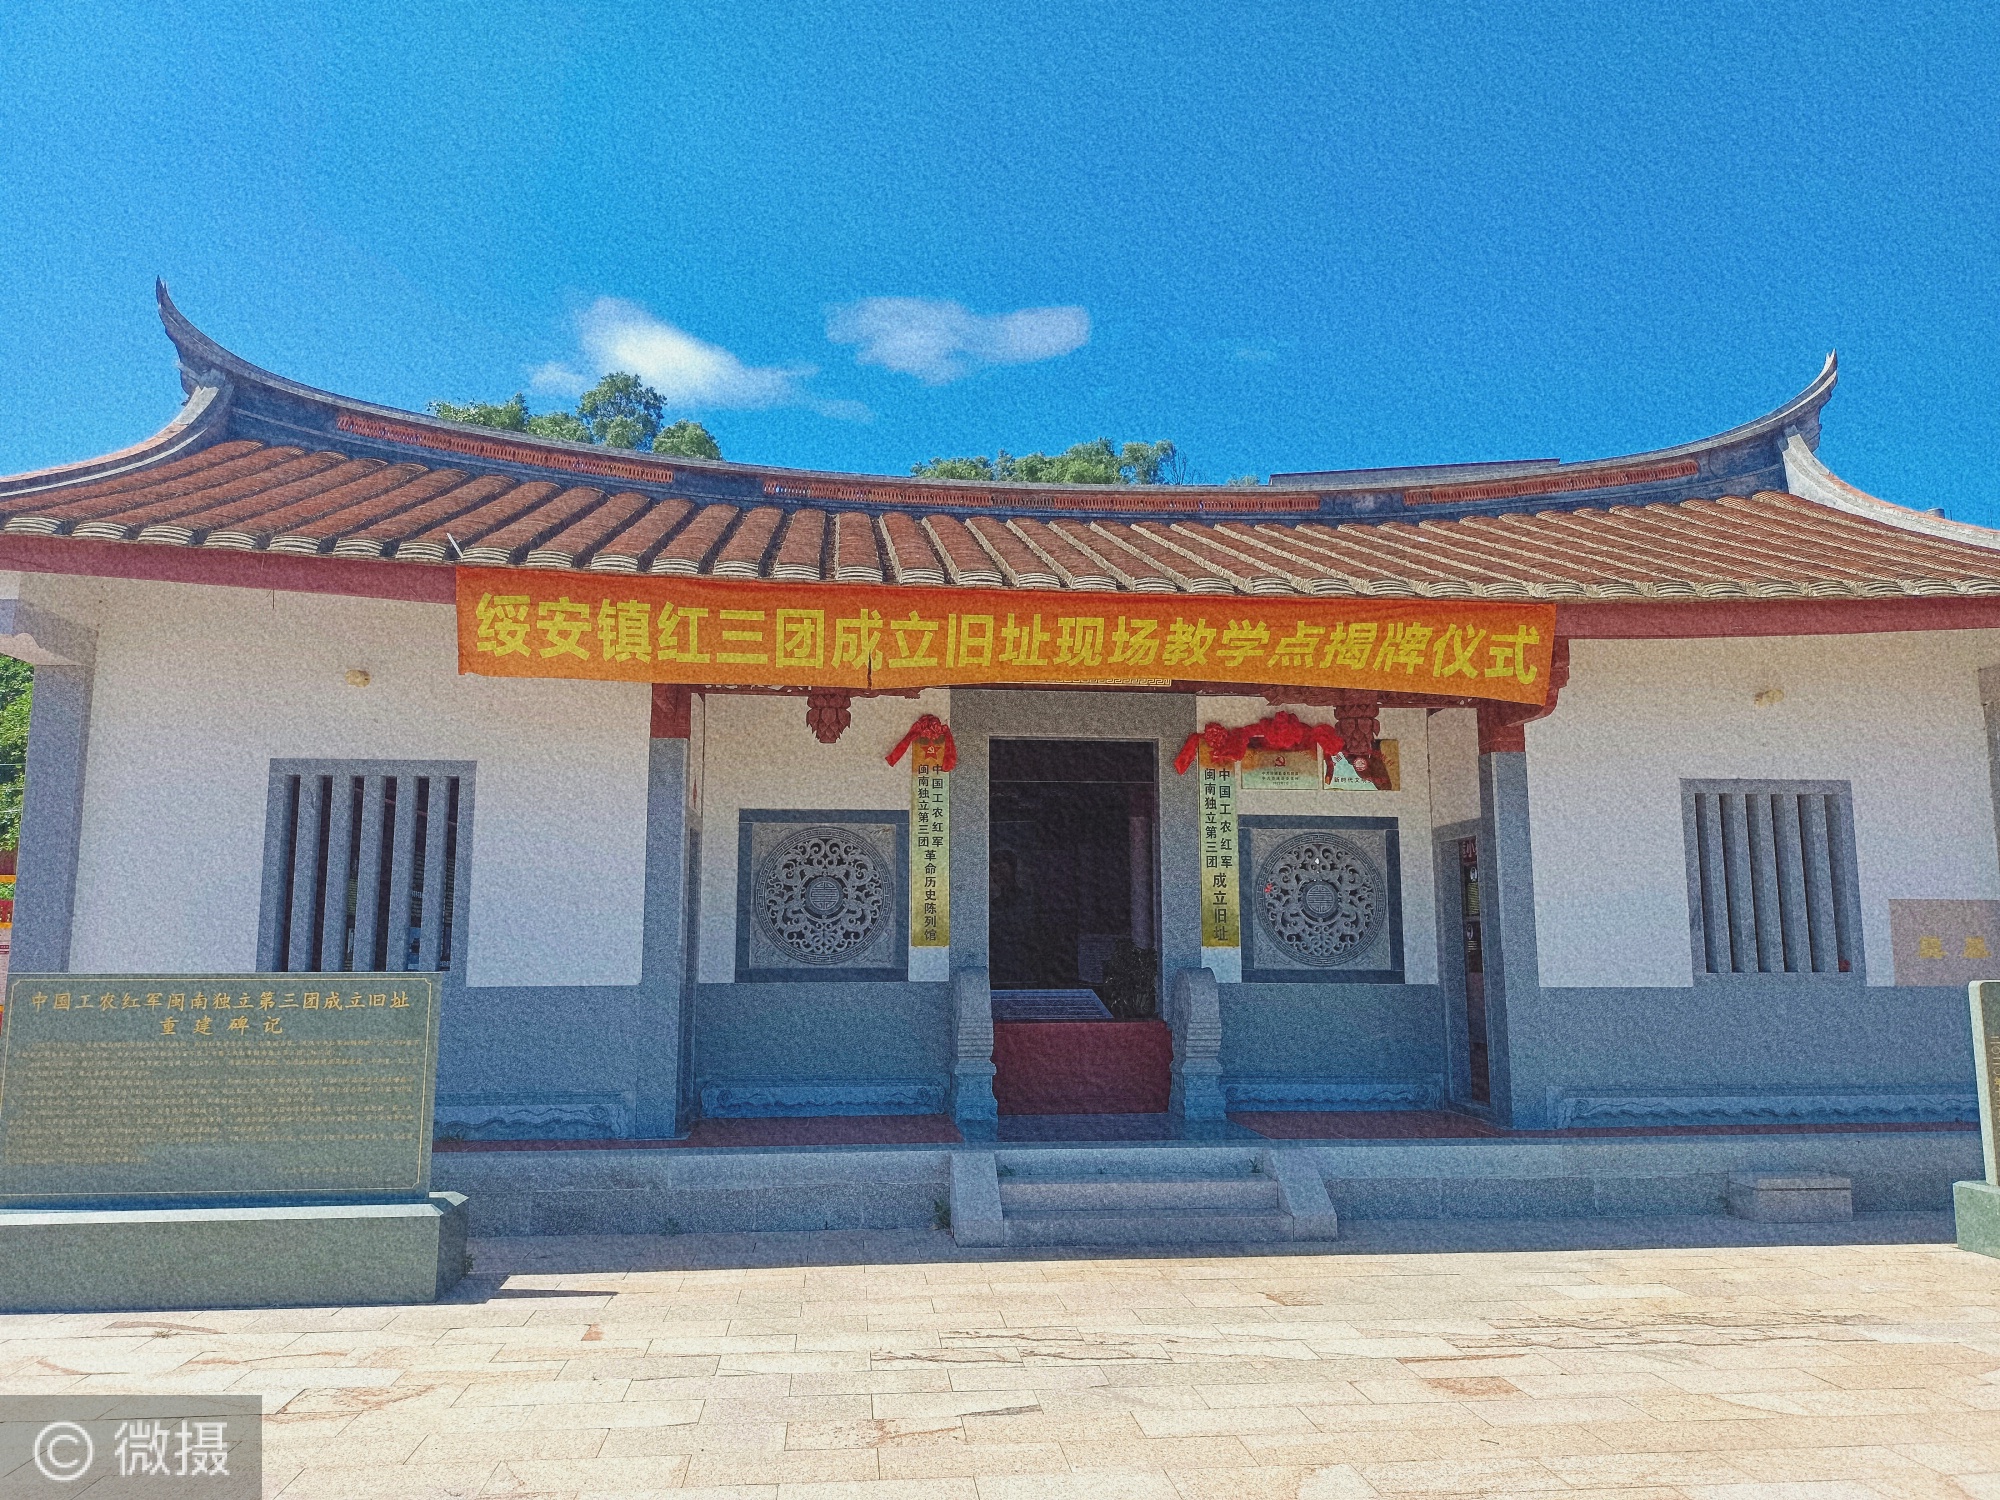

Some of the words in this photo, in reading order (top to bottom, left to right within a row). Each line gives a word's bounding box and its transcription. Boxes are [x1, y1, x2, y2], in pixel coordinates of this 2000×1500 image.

[475, 591, 1541, 686] 绥安镇红三团成立旧址现场教学点揭牌仪式
[918, 764, 930, 847] 闽南独立第三团
[932, 764, 944, 847] 中国工农红军
[1204, 768, 1218, 868] 闽南独立第三团
[1219, 768, 1233, 868] 中国工农红军
[924, 850, 937, 941] 革命历史陈列馆
[1213, 872, 1228, 941] 成立旧址
[31, 991, 410, 1012] 中国工农红军闽南独立第三团成立旧址
[159, 1015, 283, 1035] 重建碑记
